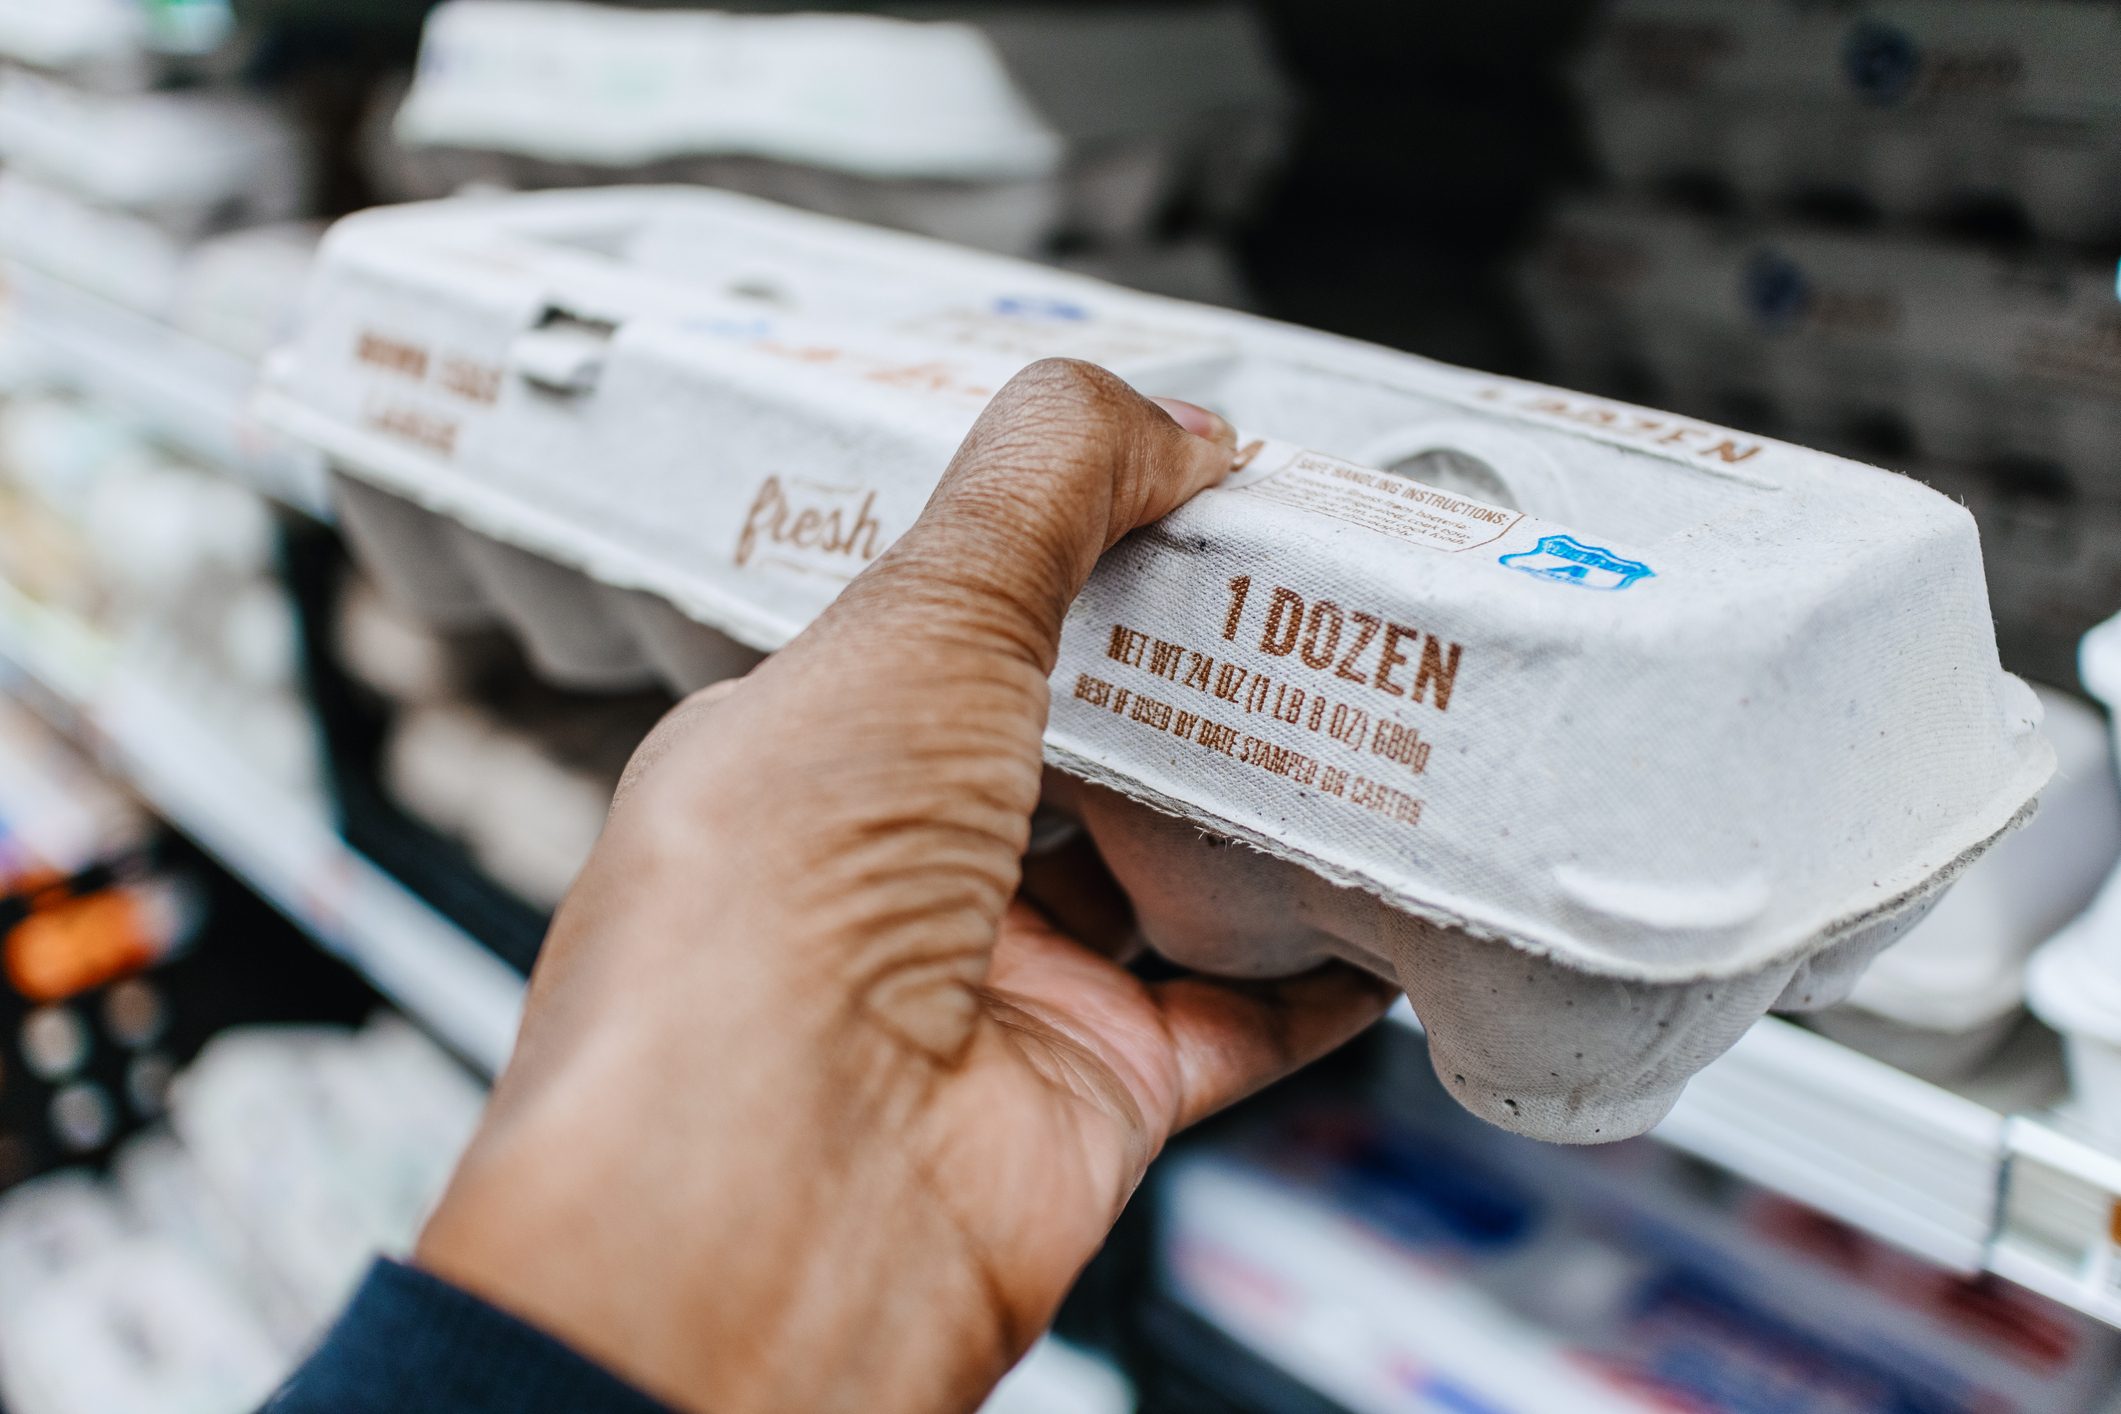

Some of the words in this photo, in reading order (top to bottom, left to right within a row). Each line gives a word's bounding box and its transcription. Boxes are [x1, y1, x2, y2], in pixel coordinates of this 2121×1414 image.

[733, 473, 882, 568] fresh
[1401, 486, 1511, 526] INSTRUCTIONS:
[1107, 624, 1149, 668] NET
[1149, 639, 1186, 681] WT
[1182, 651, 1214, 692] 24
[1215, 662, 1247, 704] OZ
[1272, 683, 1306, 725] LB
[1308, 696, 1326, 731] 8
[1329, 703, 1369, 751] OZ)
[1371, 718, 1432, 774] 680g
[1221, 575, 1251, 641] 1
[1260, 586, 1462, 712] DOZEN
[1074, 672, 1114, 708] BEST
[1113, 686, 1133, 714] IF
[1130, 694, 1173, 731] USED
[1173, 709, 1200, 740] BY
[1197, 718, 1240, 757] DATE
[1239, 735, 1319, 785] STAMPED
